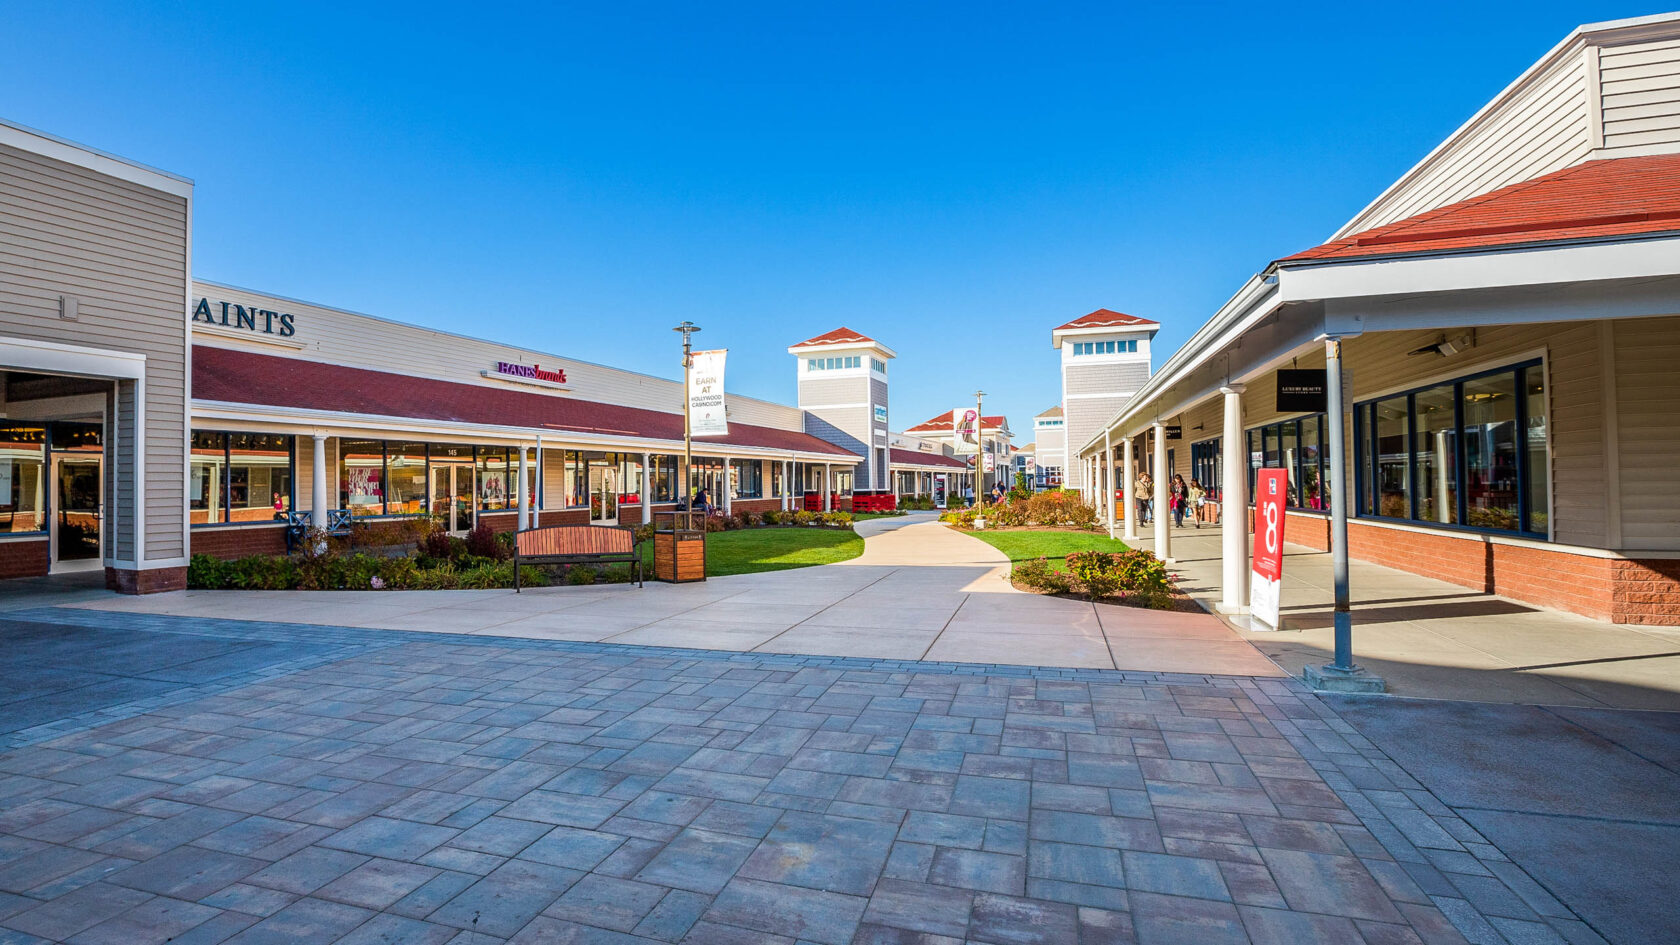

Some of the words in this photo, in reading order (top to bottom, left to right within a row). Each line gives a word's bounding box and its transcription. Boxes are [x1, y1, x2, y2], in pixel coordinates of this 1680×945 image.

[192, 298, 295, 336] AINTS
[696, 377, 717, 386] EARN
[701, 386, 712, 394] AT
